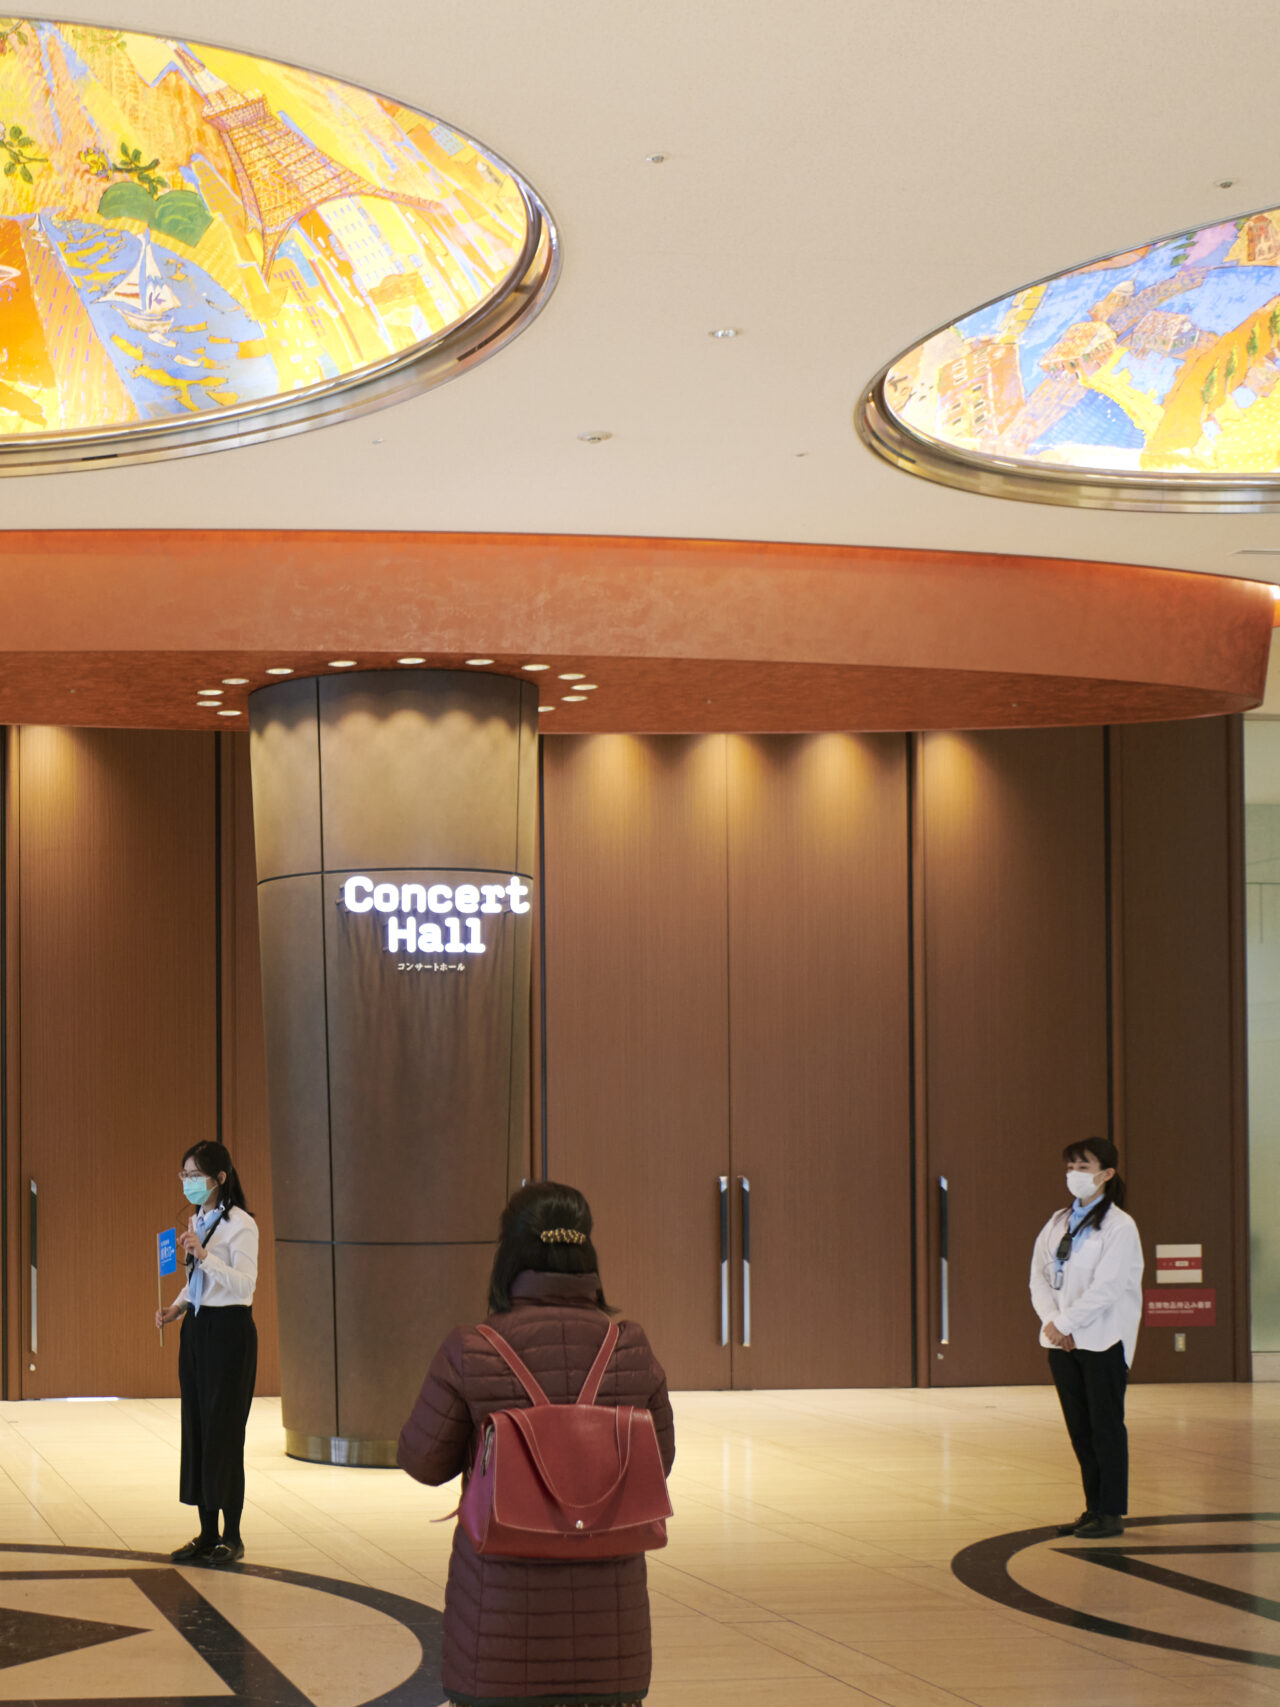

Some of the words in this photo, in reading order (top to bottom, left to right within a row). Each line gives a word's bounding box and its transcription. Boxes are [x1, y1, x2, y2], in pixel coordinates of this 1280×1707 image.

[344, 875, 531, 914] Concert
[387, 916, 487, 953] Hall
[396, 962, 466, 972] コンサートホール
